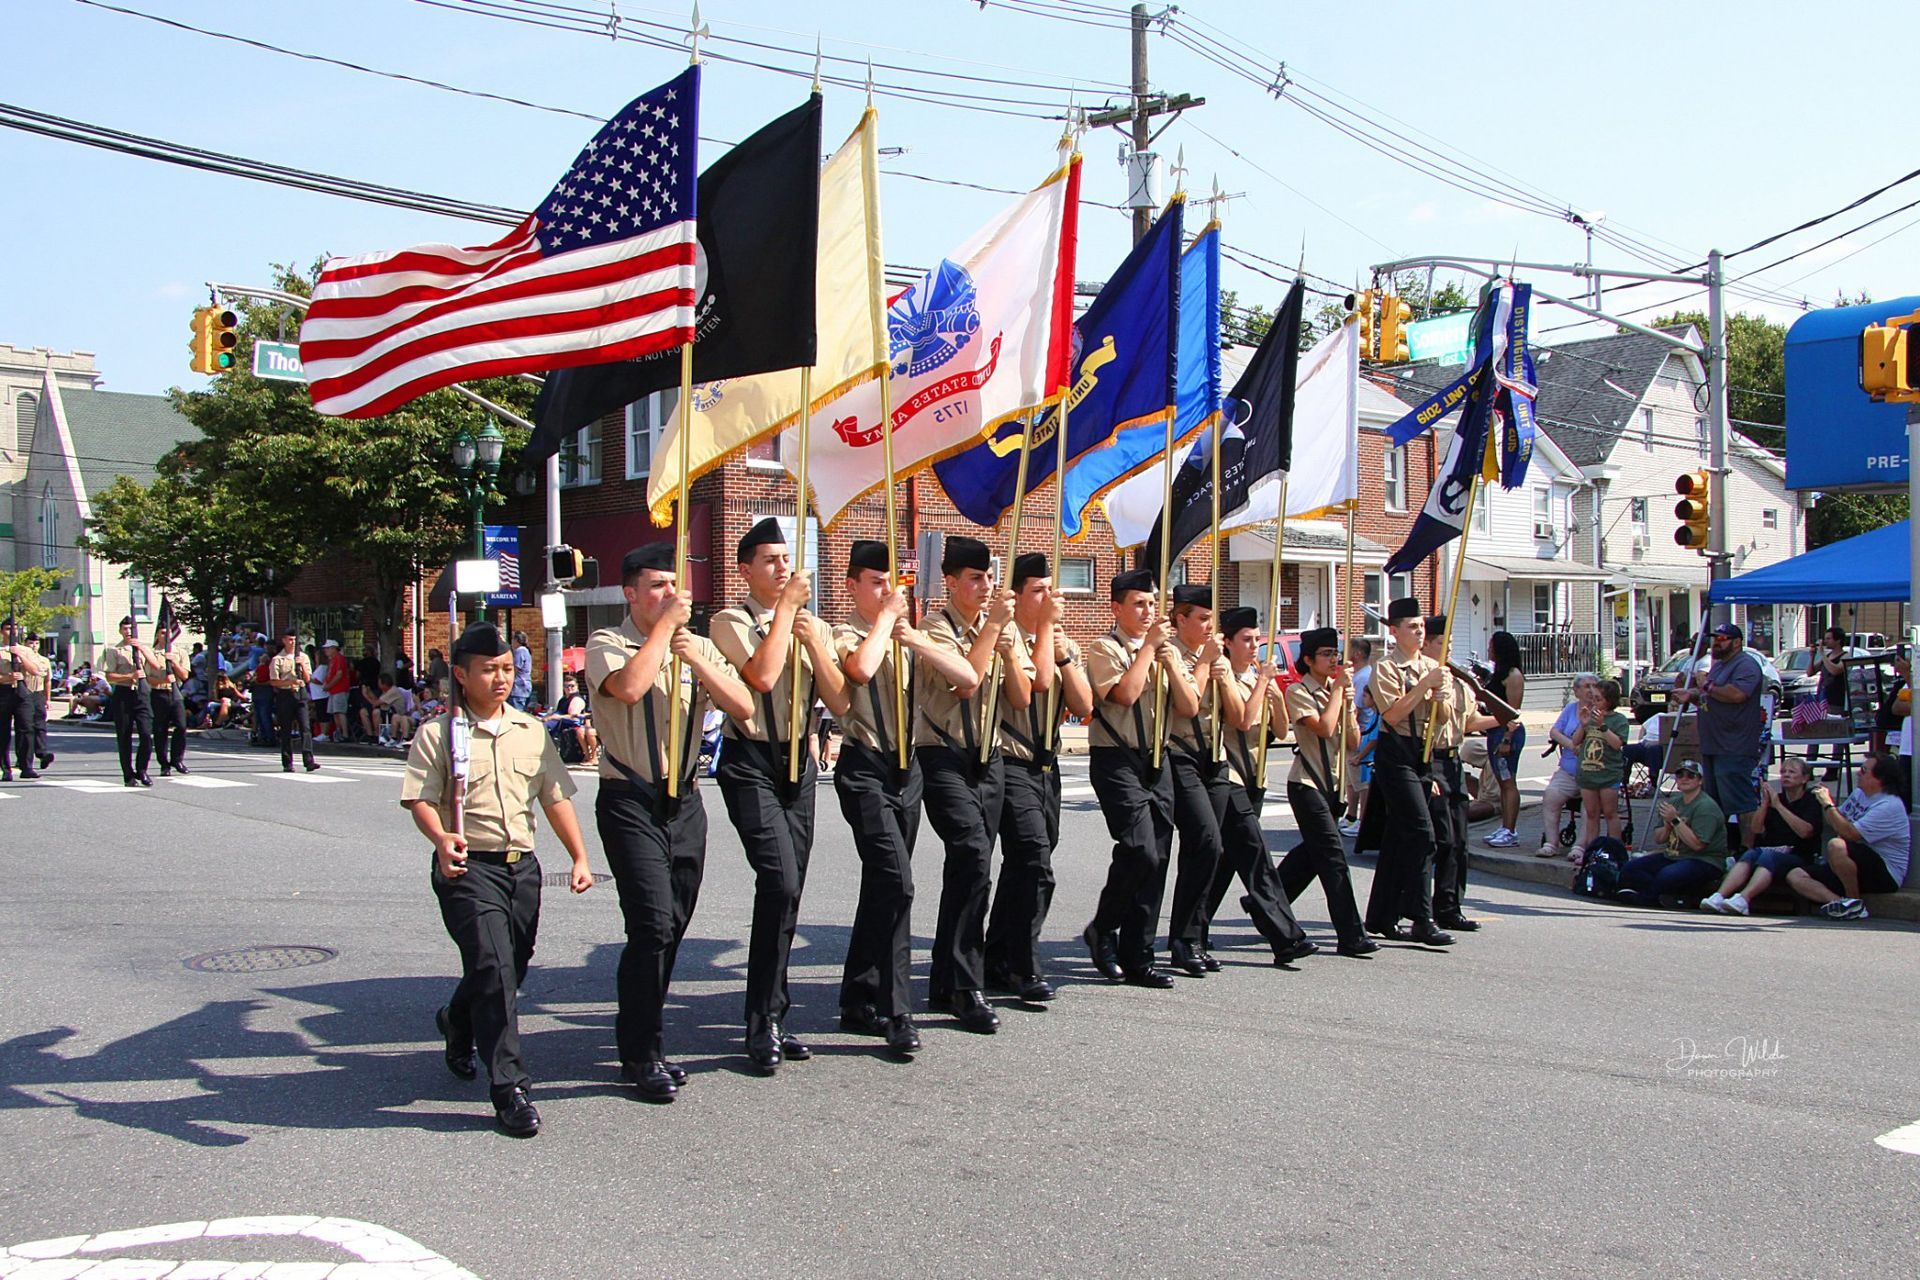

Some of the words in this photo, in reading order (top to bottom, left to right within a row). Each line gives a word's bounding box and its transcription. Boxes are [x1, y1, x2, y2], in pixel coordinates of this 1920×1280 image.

[1442, 384, 1468, 409] UNIT
[1416, 402, 1443, 424] 2019
[1517, 403, 1531, 428] UNIT
